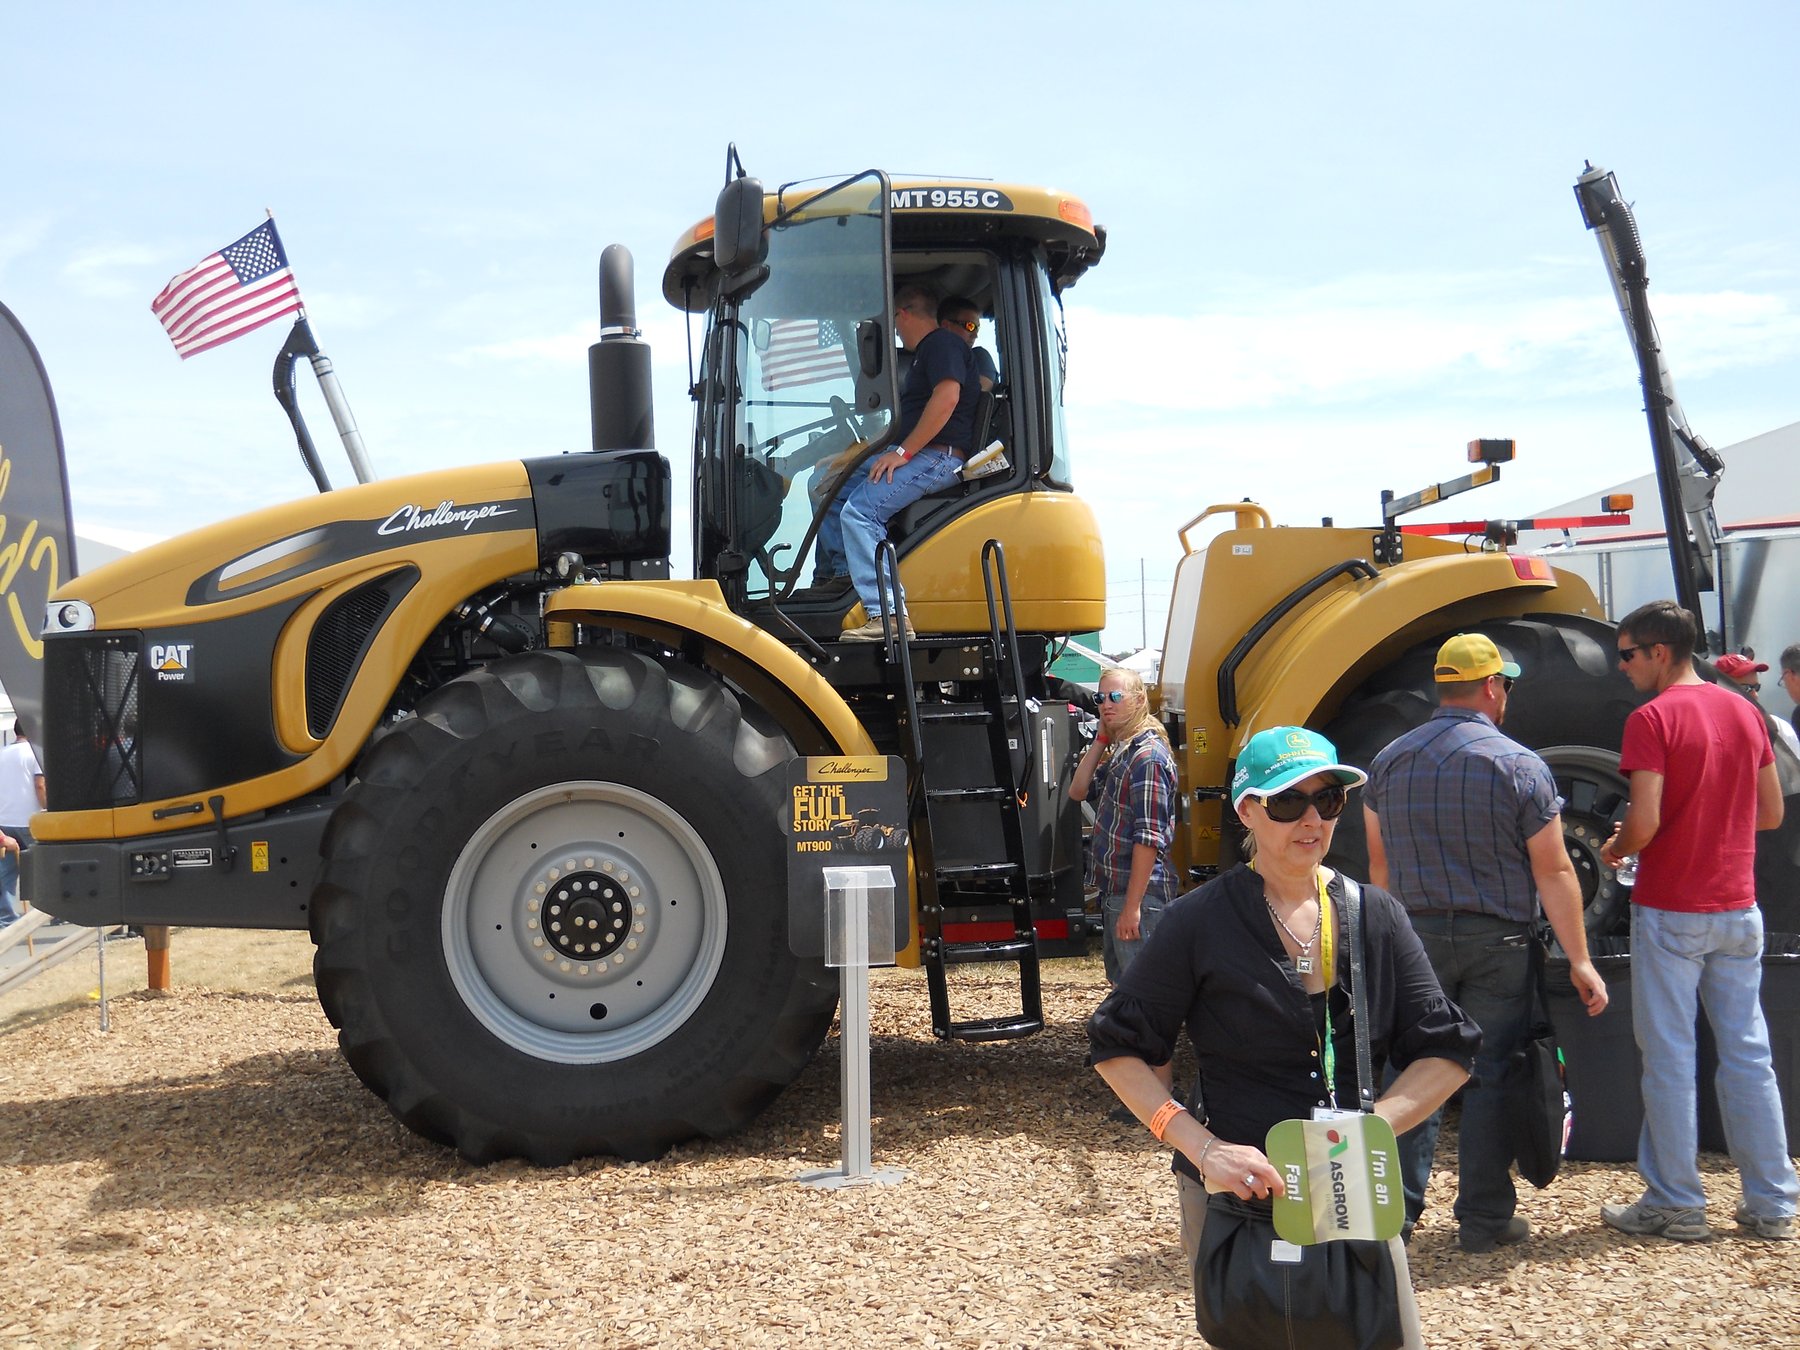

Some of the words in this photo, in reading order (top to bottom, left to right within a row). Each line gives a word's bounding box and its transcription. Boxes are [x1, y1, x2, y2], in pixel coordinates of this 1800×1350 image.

[377, 500, 518, 536] Challenger
[151, 645, 191, 670] CAT
[158, 672, 185, 681] Power
[818, 761, 880, 778] Challenger
[793, 785, 817, 798] GET
[819, 784, 844, 798] THE
[794, 796, 853, 821] FULL
[793, 819, 834, 833] STORY.
[796, 840, 832, 853] MT900
[1371, 1150, 1387, 1178] I'm
[1284, 1163, 1304, 1201] Fan!
[1330, 1160, 1350, 1231] ASGROW
[1375, 1184, 1389, 1205] an
